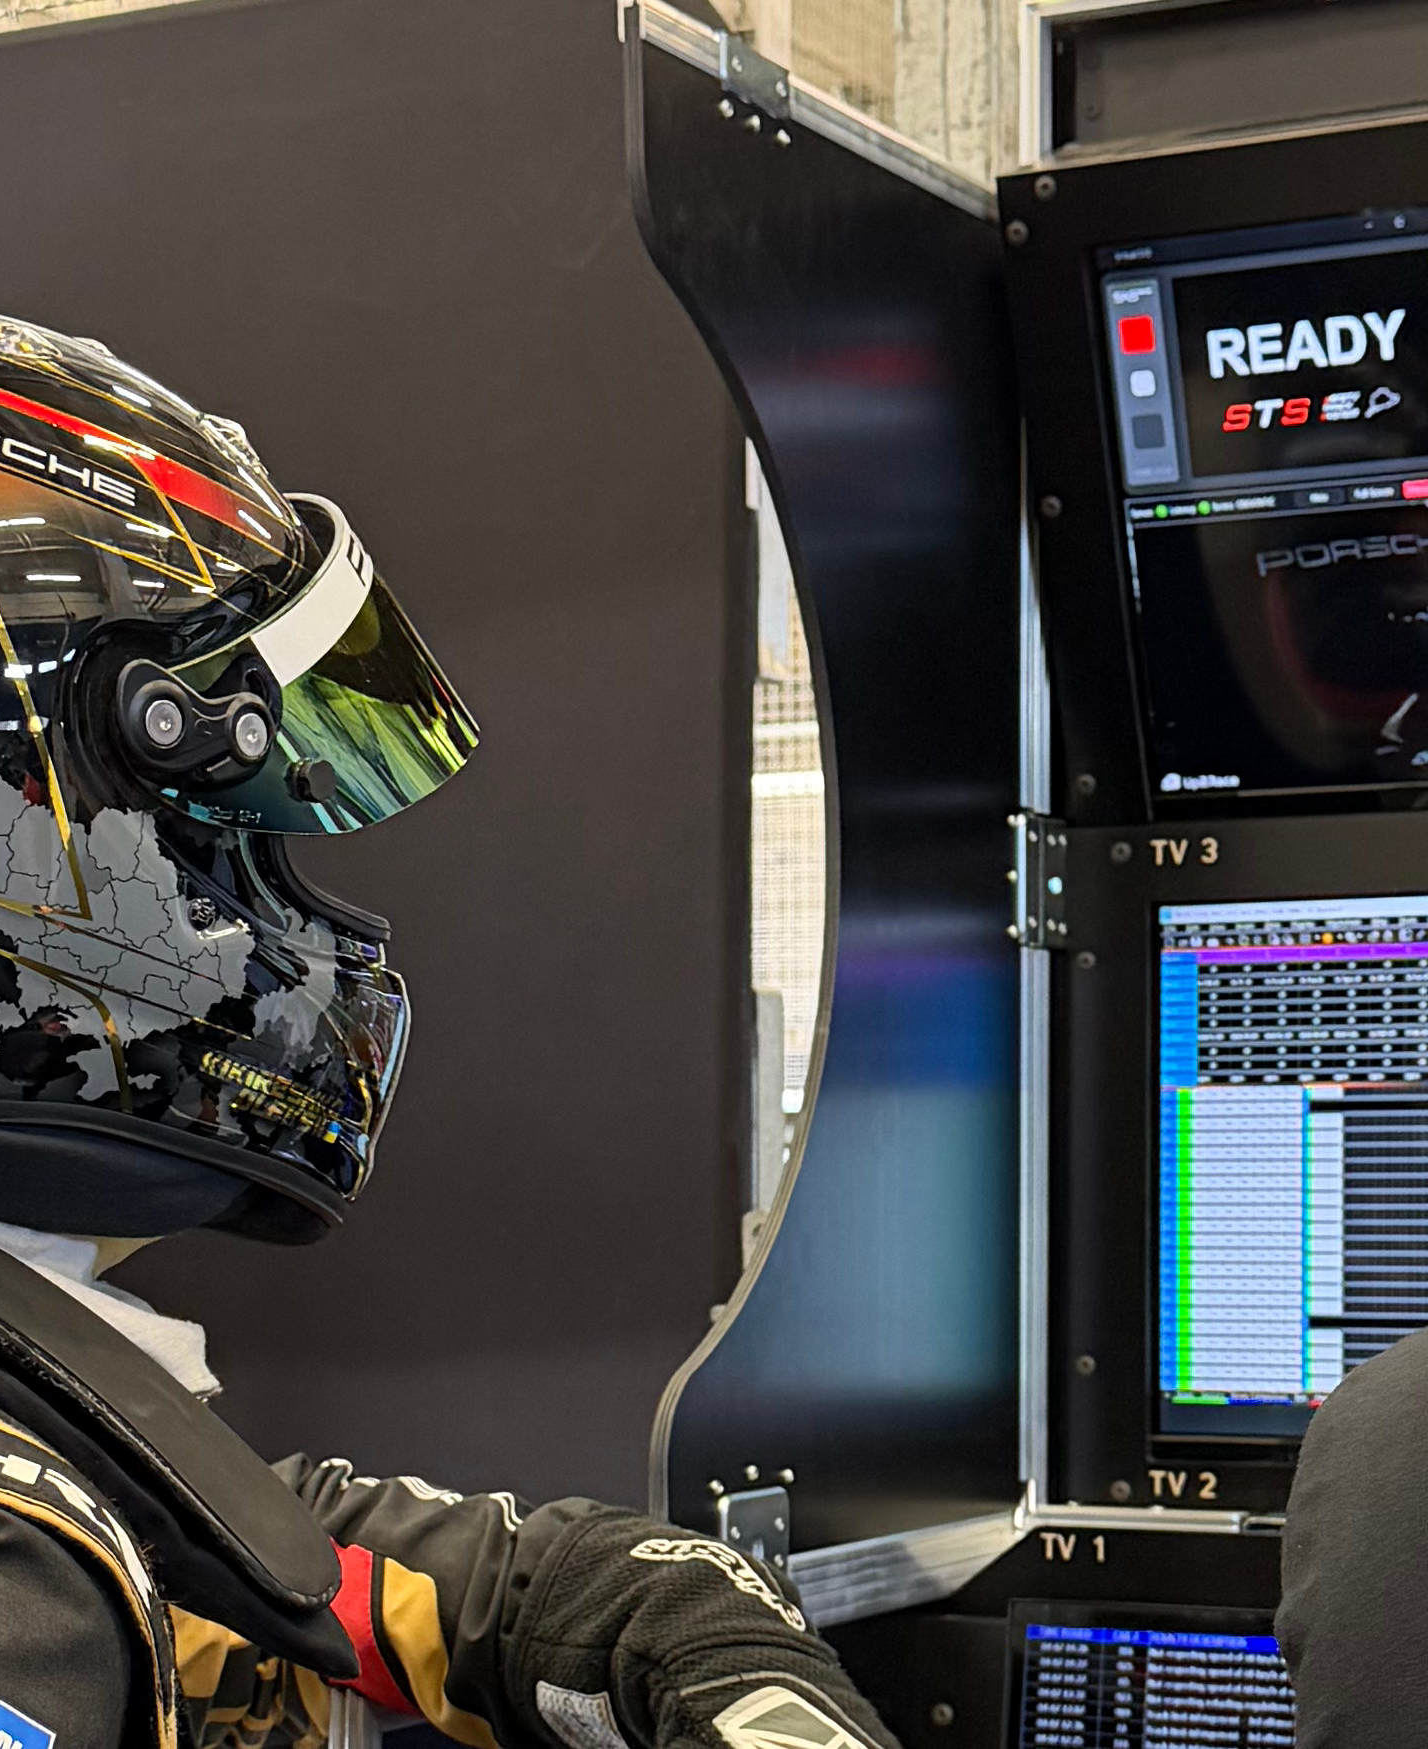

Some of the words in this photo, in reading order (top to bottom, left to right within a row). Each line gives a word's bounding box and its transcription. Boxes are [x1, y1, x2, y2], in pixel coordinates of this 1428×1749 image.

[1206, 308, 1406, 379] READY
[1222, 397, 1311, 433] STS
[1150, 838, 1189, 866] TV
[1200, 838, 1219, 865] 3
[1149, 1470, 1184, 1497] TV
[1198, 1472, 1217, 1499] 2
[1039, 1532, 1076, 1561] TV
[1092, 1535, 1106, 1563] 1
